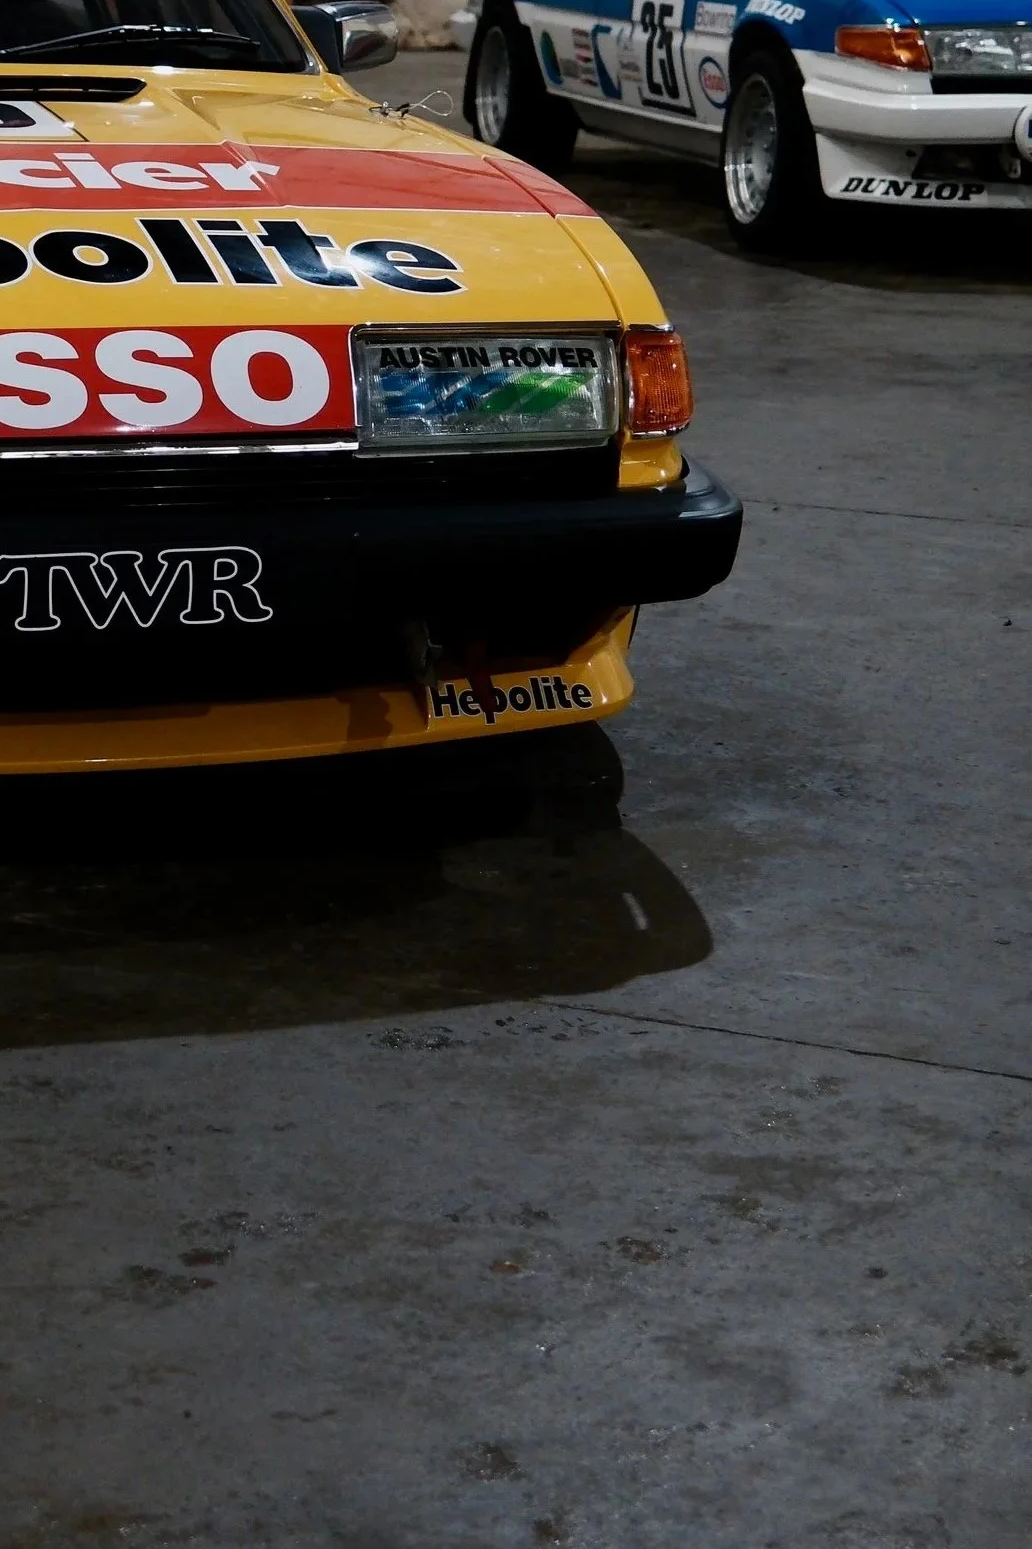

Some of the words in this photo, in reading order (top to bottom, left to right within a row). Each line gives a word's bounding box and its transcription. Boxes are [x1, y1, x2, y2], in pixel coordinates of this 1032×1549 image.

[640, 0, 681, 100] 25
[840, 177, 986, 201] DUNLOP
[379, 347, 493, 369] AUSTIN
[498, 346, 599, 369] ROVER
[429, 675, 594, 725] Hepolite
